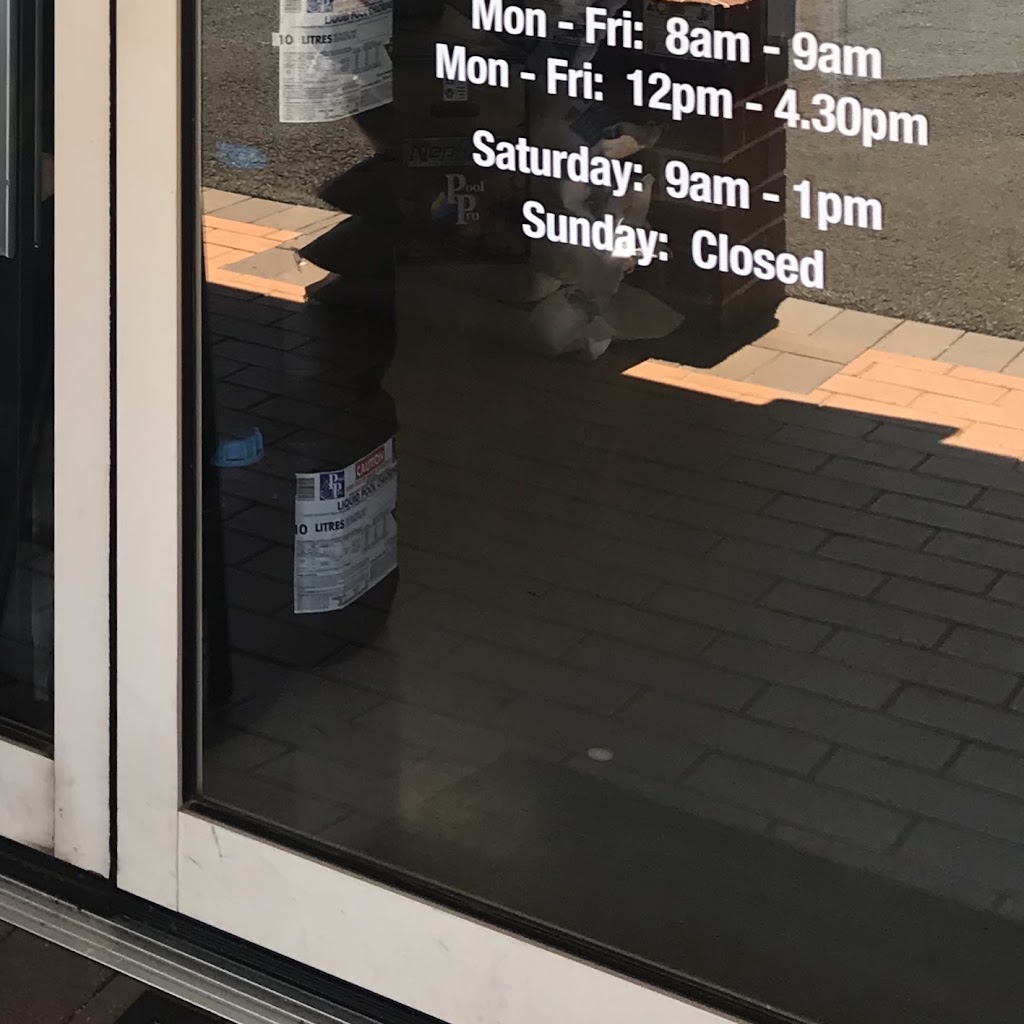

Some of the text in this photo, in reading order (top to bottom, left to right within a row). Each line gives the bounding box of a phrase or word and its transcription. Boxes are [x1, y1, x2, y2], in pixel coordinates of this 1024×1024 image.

[279, 35, 294, 45] 10
[302, 34, 333, 45] LITRES
[558, 21, 573, 30] -
[585, 7, 643, 50] Fri:
[665, 17, 750, 63] 8am
[763, 45, 780, 55] -
[792, 31, 882, 79] 9am
[435, 42, 509, 88] Mon
[520, 72, 536, 81] -
[546, 58, 604, 101] Fri:
[626, 69, 733, 122] 12pm
[746, 102, 764, 113] -
[774, 88, 929, 148] 4.30pm
[445, 173, 485, 205] Pool
[472, 130, 883, 231] Saturday: 9am - 1pm
[456, 193, 480, 225] Pro
[521, 201, 825, 289] Sunday: Closed
[296, 520, 345, 535] 10 LITRES
